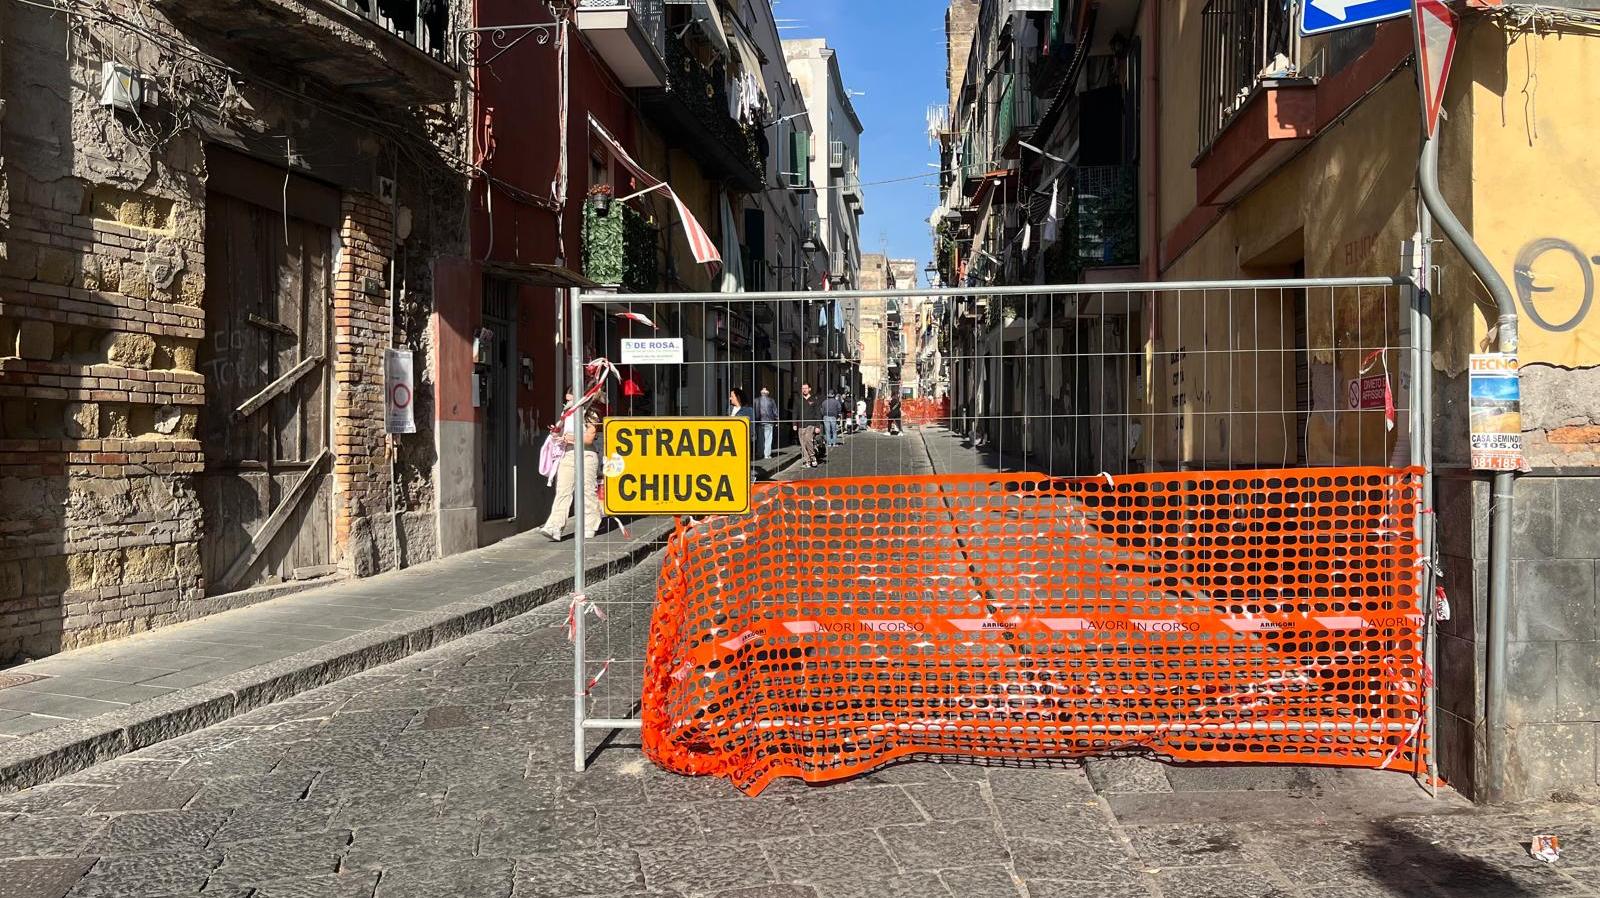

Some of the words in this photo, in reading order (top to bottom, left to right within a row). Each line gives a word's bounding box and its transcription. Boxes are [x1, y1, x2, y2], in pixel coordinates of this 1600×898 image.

[1471, 358, 1518, 370] TECNO
[615, 428, 737, 457] STRADA
[1471, 434, 1491, 443] CASA
[618, 473, 735, 502] CHIUSA
[813, 622, 856, 633] LAVORI
[860, 622, 874, 632] IN
[878, 621, 925, 632] CORSO
[1080, 621, 1128, 632] LAVORI
[1132, 621, 1147, 632] IN
[1152, 621, 1200, 633] CORSO
[1361, 618, 1408, 629] LAVORI
